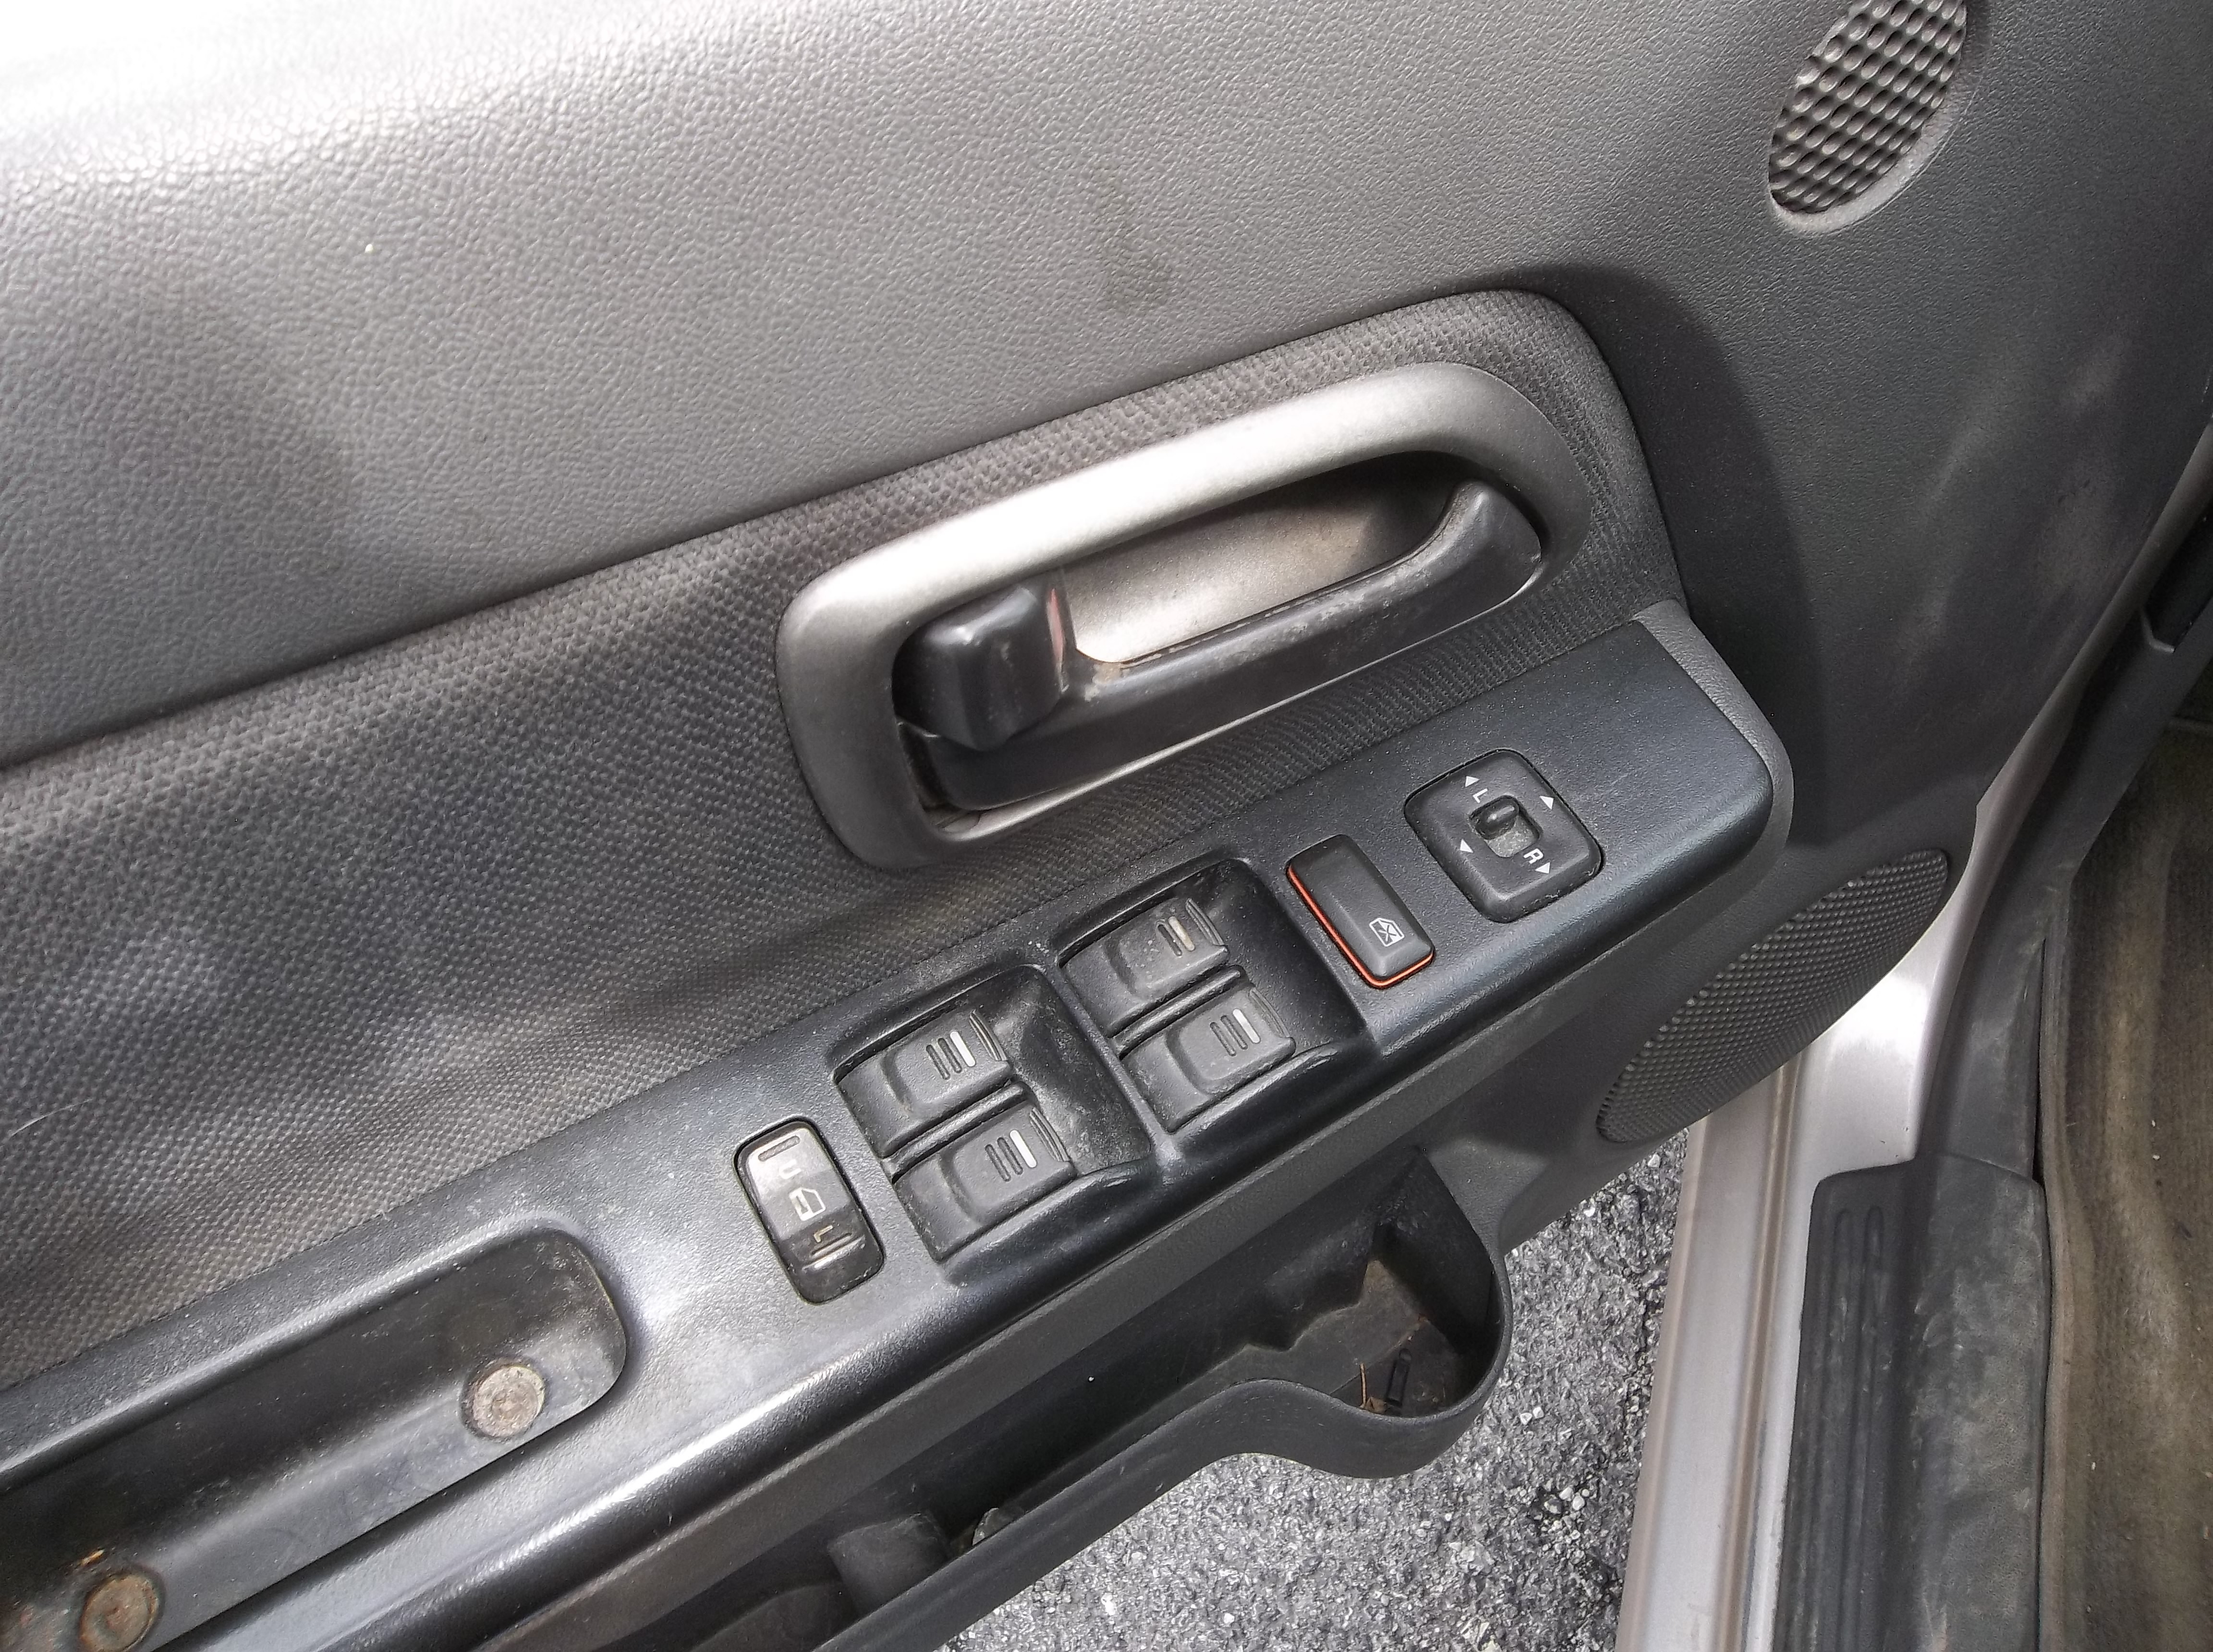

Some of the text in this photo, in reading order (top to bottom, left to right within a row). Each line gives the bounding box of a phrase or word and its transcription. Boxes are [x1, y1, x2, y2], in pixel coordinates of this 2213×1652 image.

[1472, 788, 1488, 803] L
[1523, 848, 1544, 864] R
[778, 1159, 802, 1179] U
[814, 1225, 833, 1243] L
